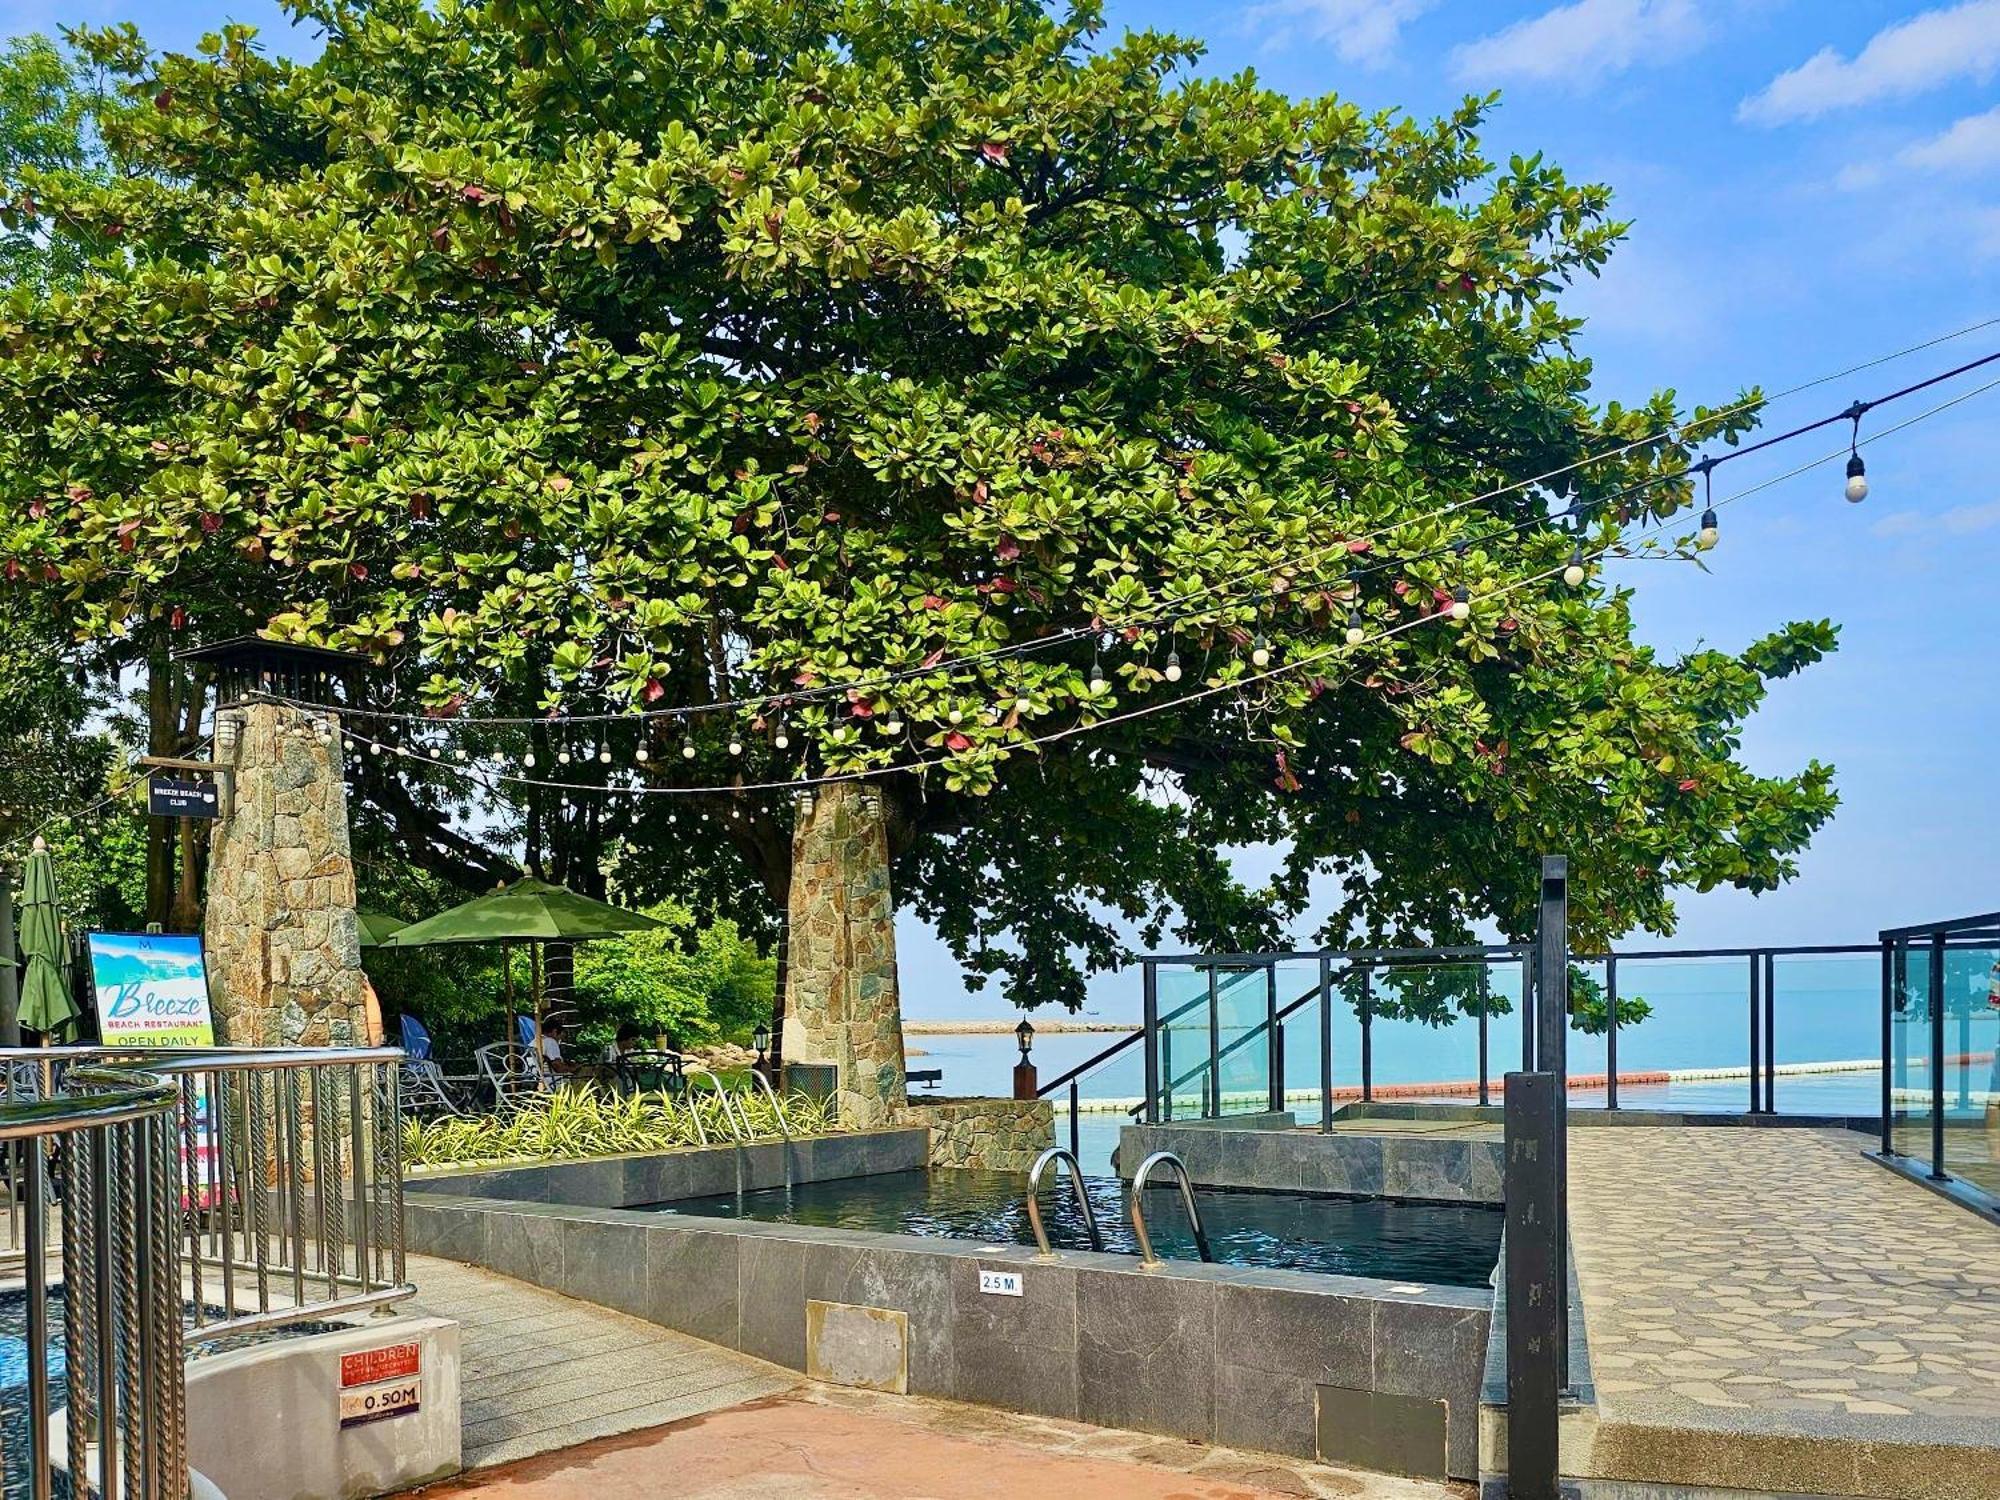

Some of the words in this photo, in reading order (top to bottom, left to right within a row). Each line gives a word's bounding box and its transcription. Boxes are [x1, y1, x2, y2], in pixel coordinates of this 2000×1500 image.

[104, 980, 202, 1018] Breeze
[107, 1021, 140, 1029] BEACH
[144, 1020, 204, 1029] RESTAURANT
[118, 1036, 156, 1046] OPEN
[161, 1036, 199, 1046] DAILY
[983, 1275, 1001, 1289] 2.5
[344, 1343, 417, 1369] CHILDREN
[364, 1387, 416, 1410] 0.50M
